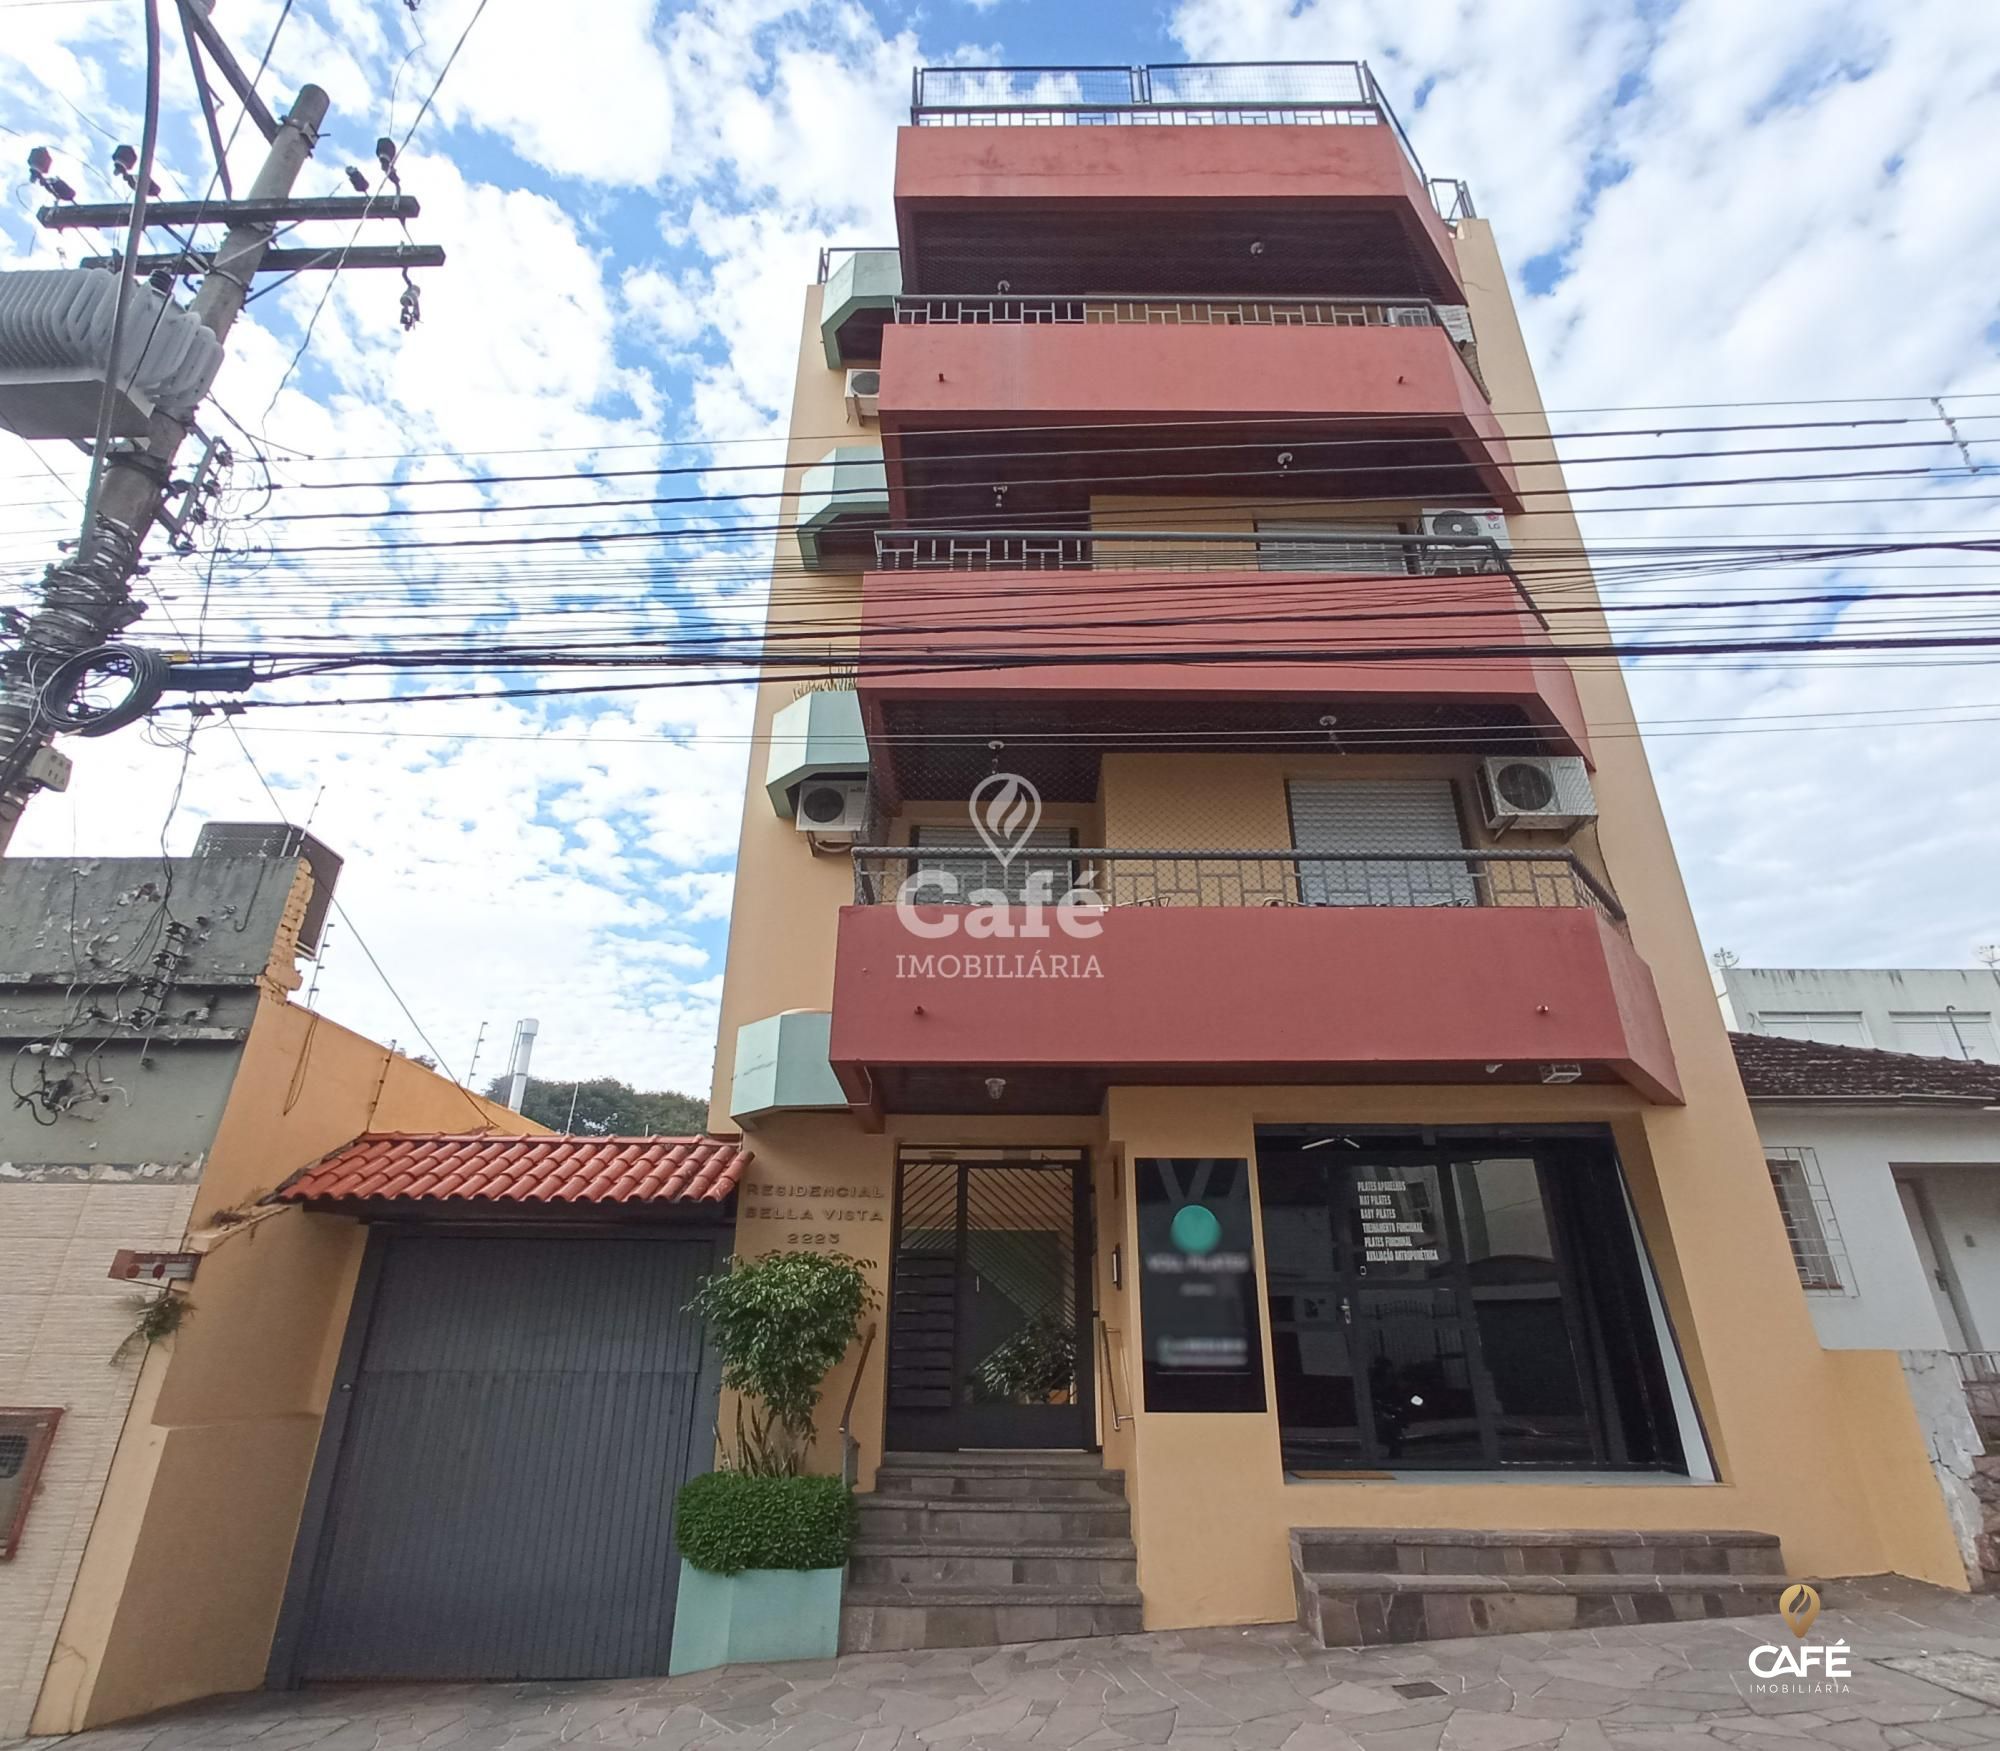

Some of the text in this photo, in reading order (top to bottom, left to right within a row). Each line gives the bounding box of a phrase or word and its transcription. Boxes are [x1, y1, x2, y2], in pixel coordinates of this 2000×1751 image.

[1488, 522, 1501, 530] LG
[746, 1183, 885, 1199] RESIDENCIAL
[745, 1207, 884, 1222] BELLA VISTA
[787, 1233, 840, 1245] 2223
